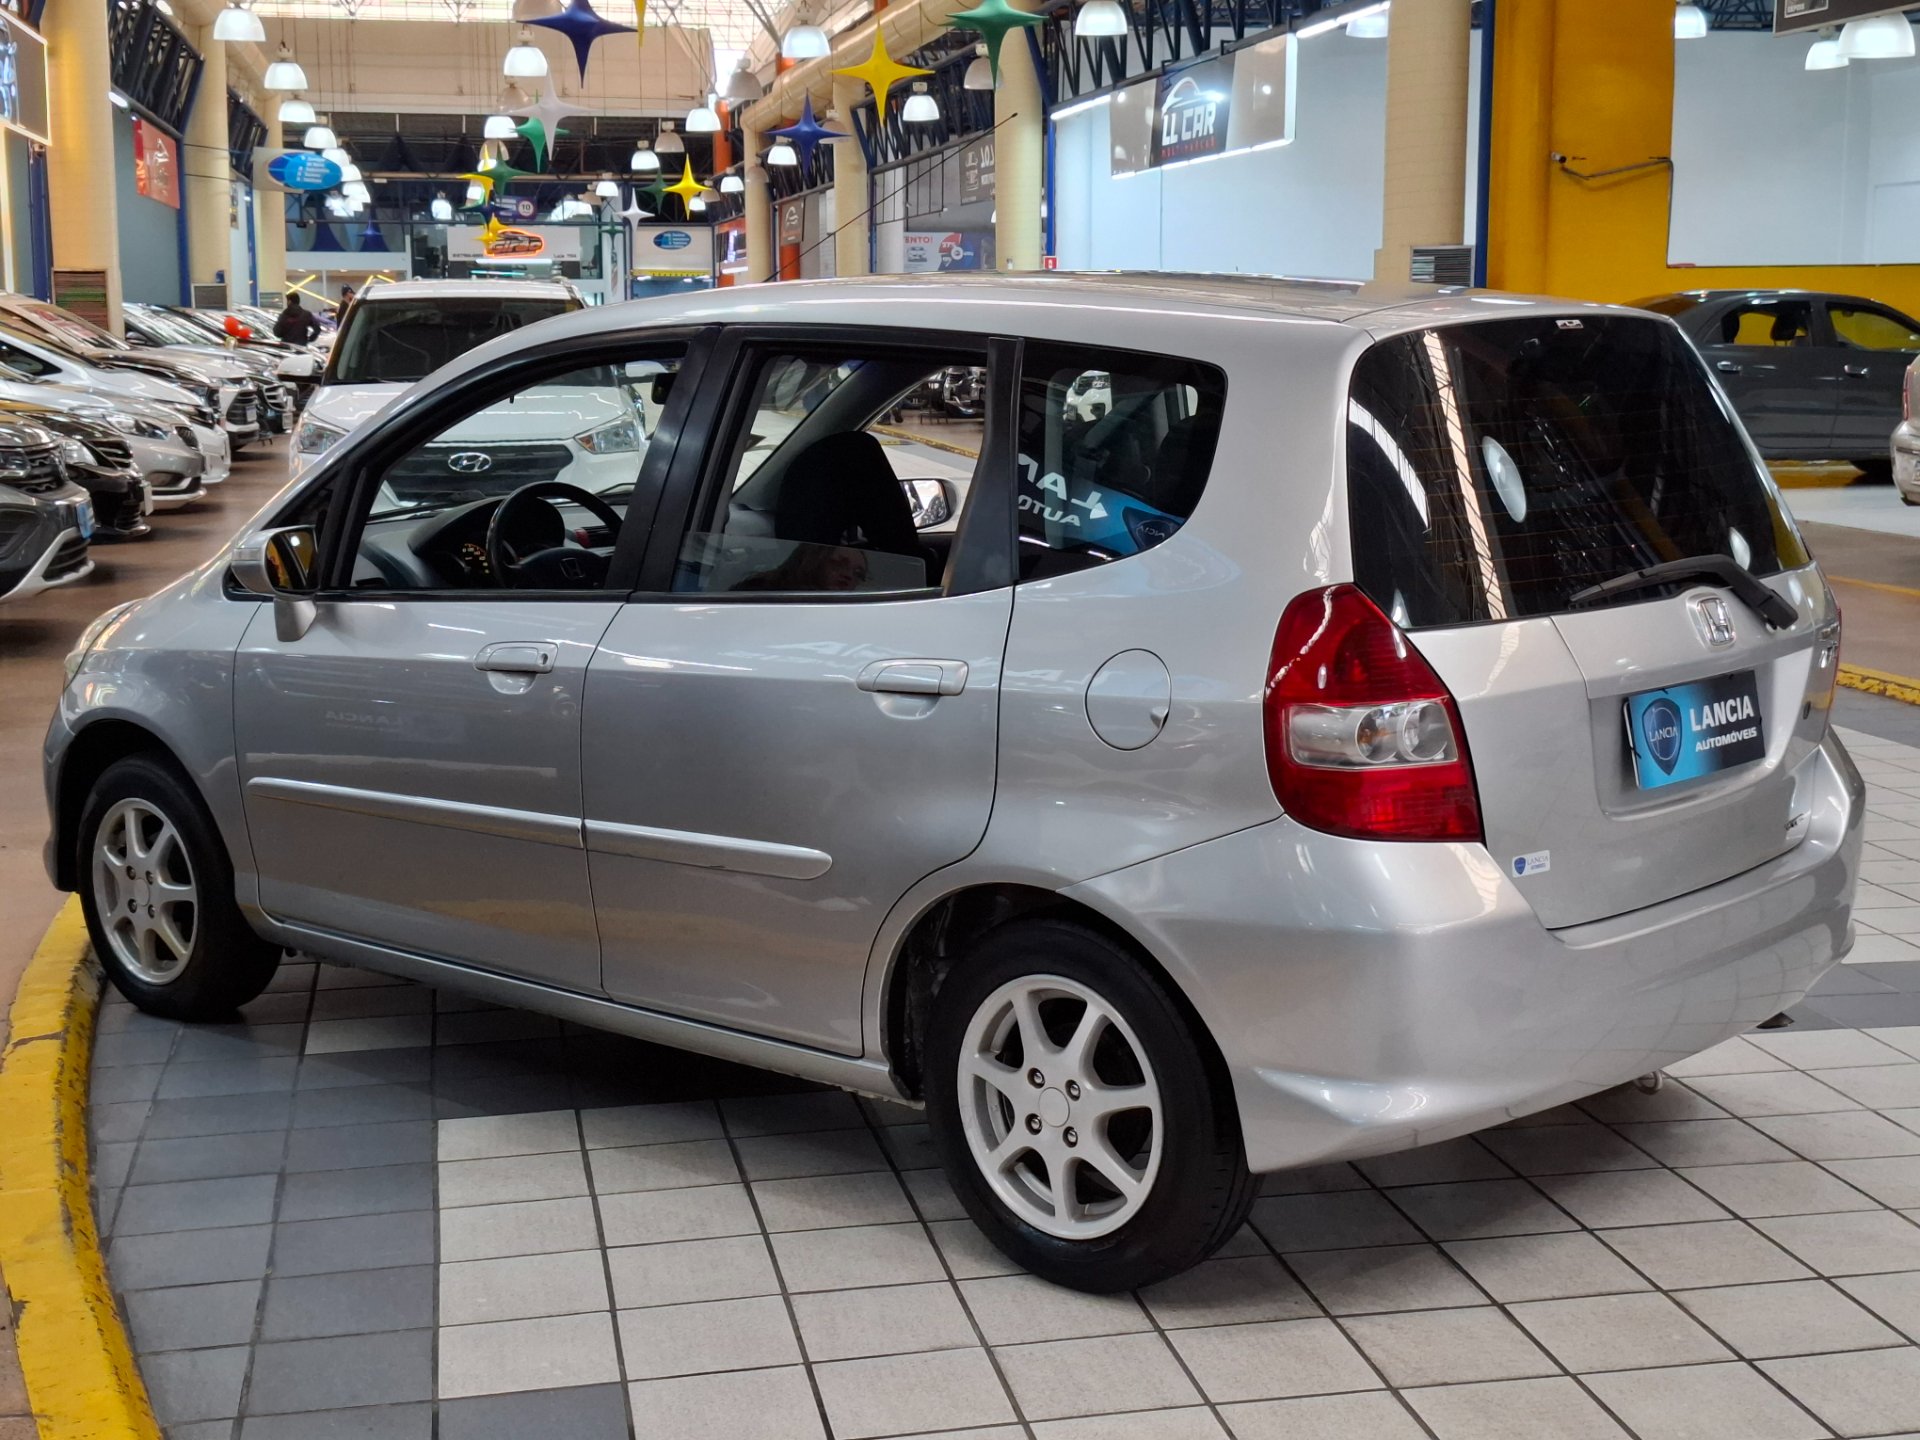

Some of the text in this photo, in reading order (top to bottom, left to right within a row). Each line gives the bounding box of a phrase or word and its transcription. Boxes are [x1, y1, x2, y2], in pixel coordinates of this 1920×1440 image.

[1182, 102, 1216, 142] CAR
[1689, 695, 1755, 732] LANCIA
[1649, 726, 1678, 743] LANCIA
[1695, 726, 1758, 752] AUTOMÓVEIS
